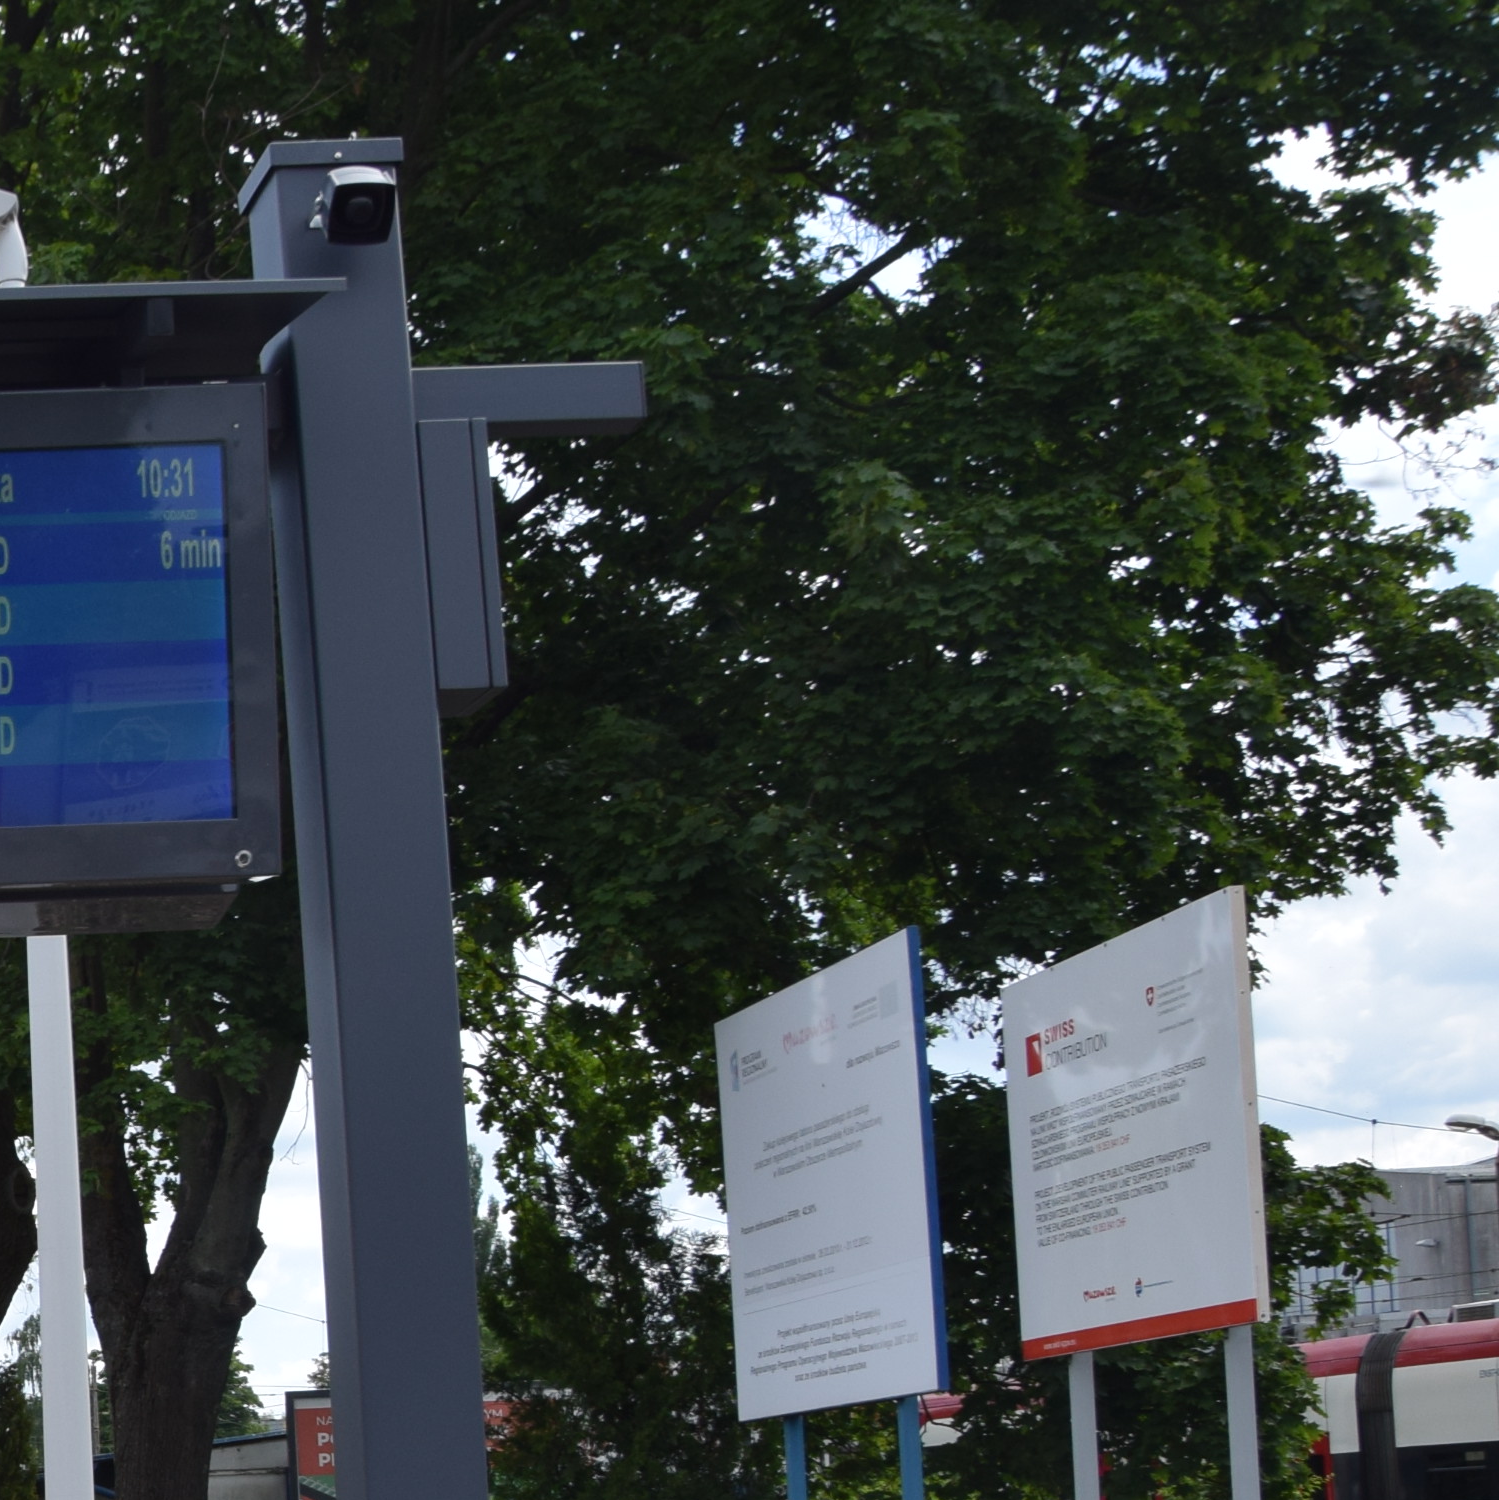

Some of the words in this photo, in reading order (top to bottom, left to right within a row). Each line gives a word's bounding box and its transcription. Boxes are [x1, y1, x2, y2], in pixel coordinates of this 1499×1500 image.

[137, 458, 195, 498] 10:31
[160, 531, 173, 570] 6
[180, 529, 222, 569] min
[1044, 1019, 1075, 1045] SWISS
[1045, 1033, 1107, 1070] CONTRIBUTION
